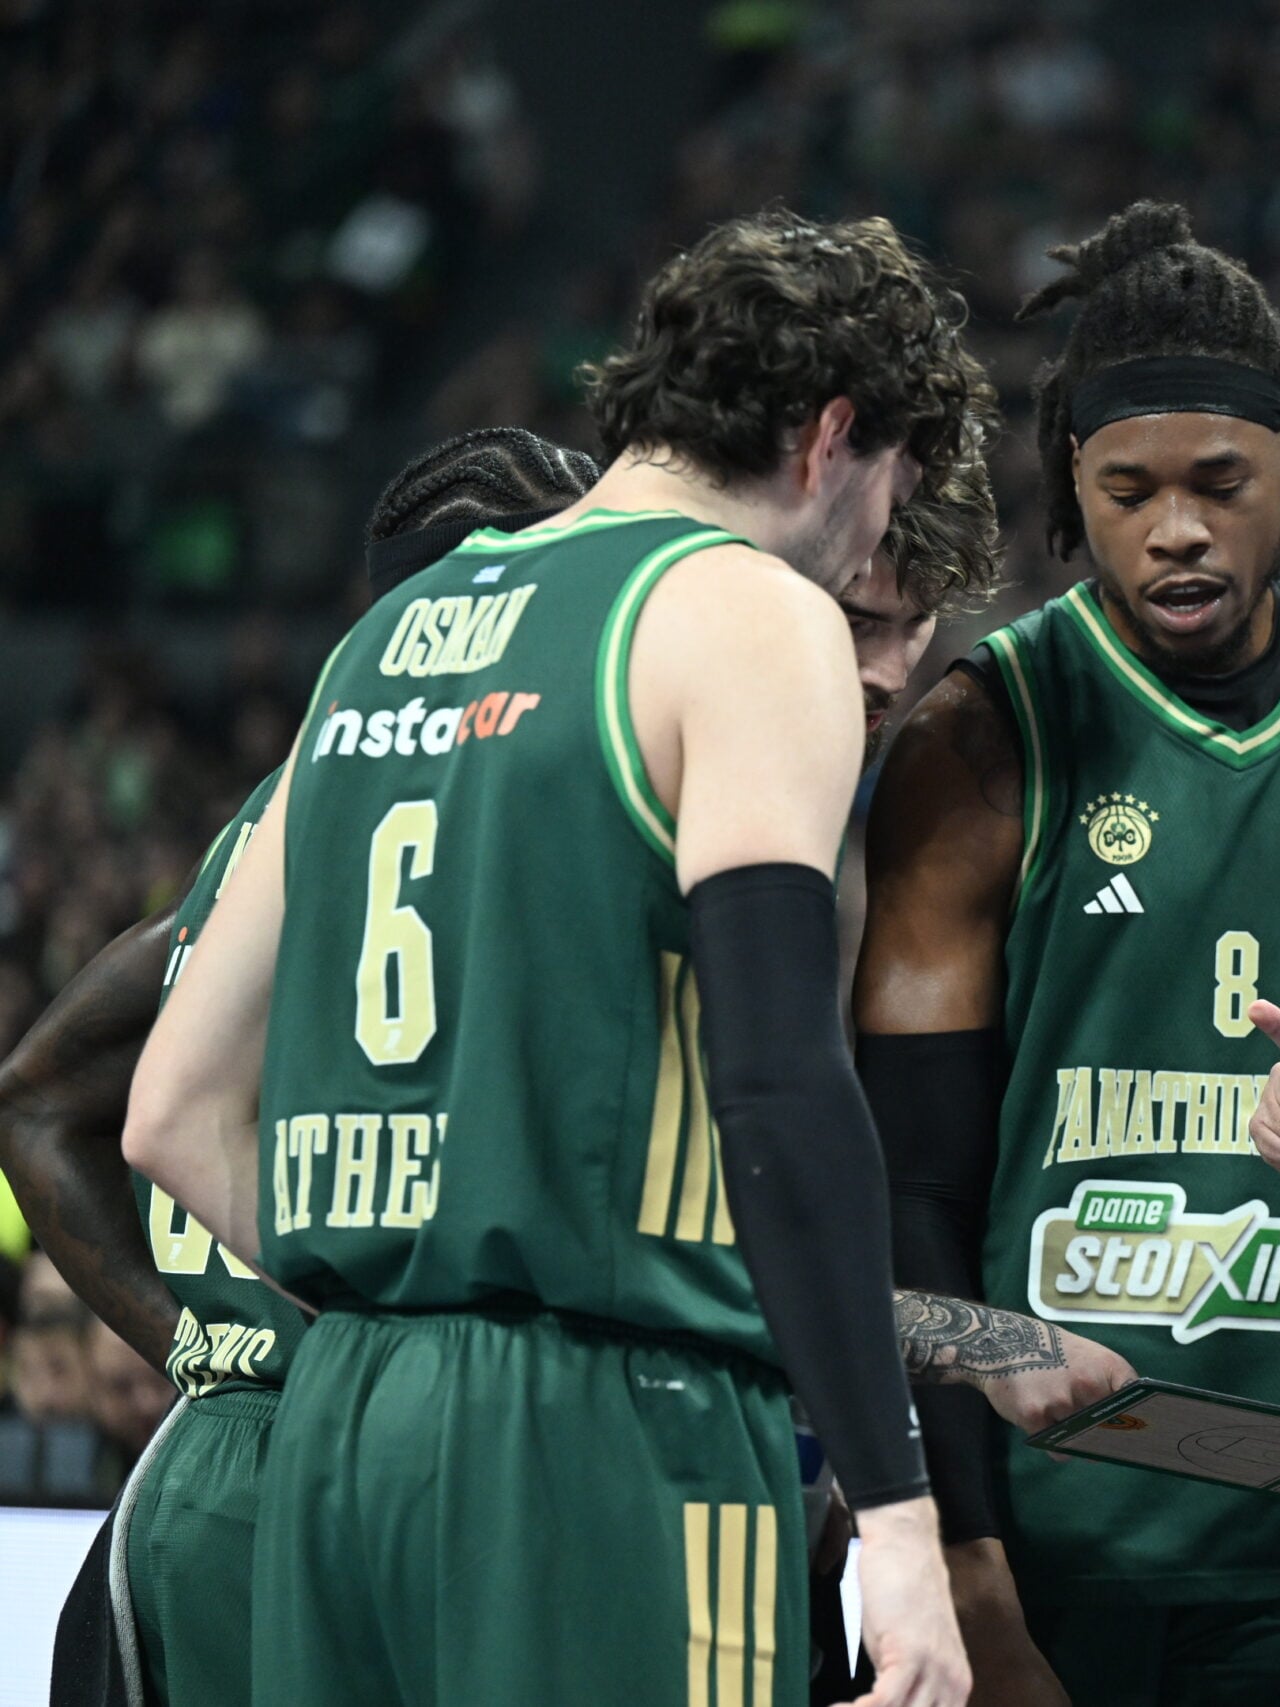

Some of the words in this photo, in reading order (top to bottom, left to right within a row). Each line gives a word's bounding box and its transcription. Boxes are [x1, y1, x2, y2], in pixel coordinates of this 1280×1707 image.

[379, 583, 538, 677] OSMAN
[312, 691, 541, 764] instacar
[355, 800, 438, 1066] 6
[1213, 930, 1260, 1038] 8
[1084, 1196, 1165, 1226] pame
